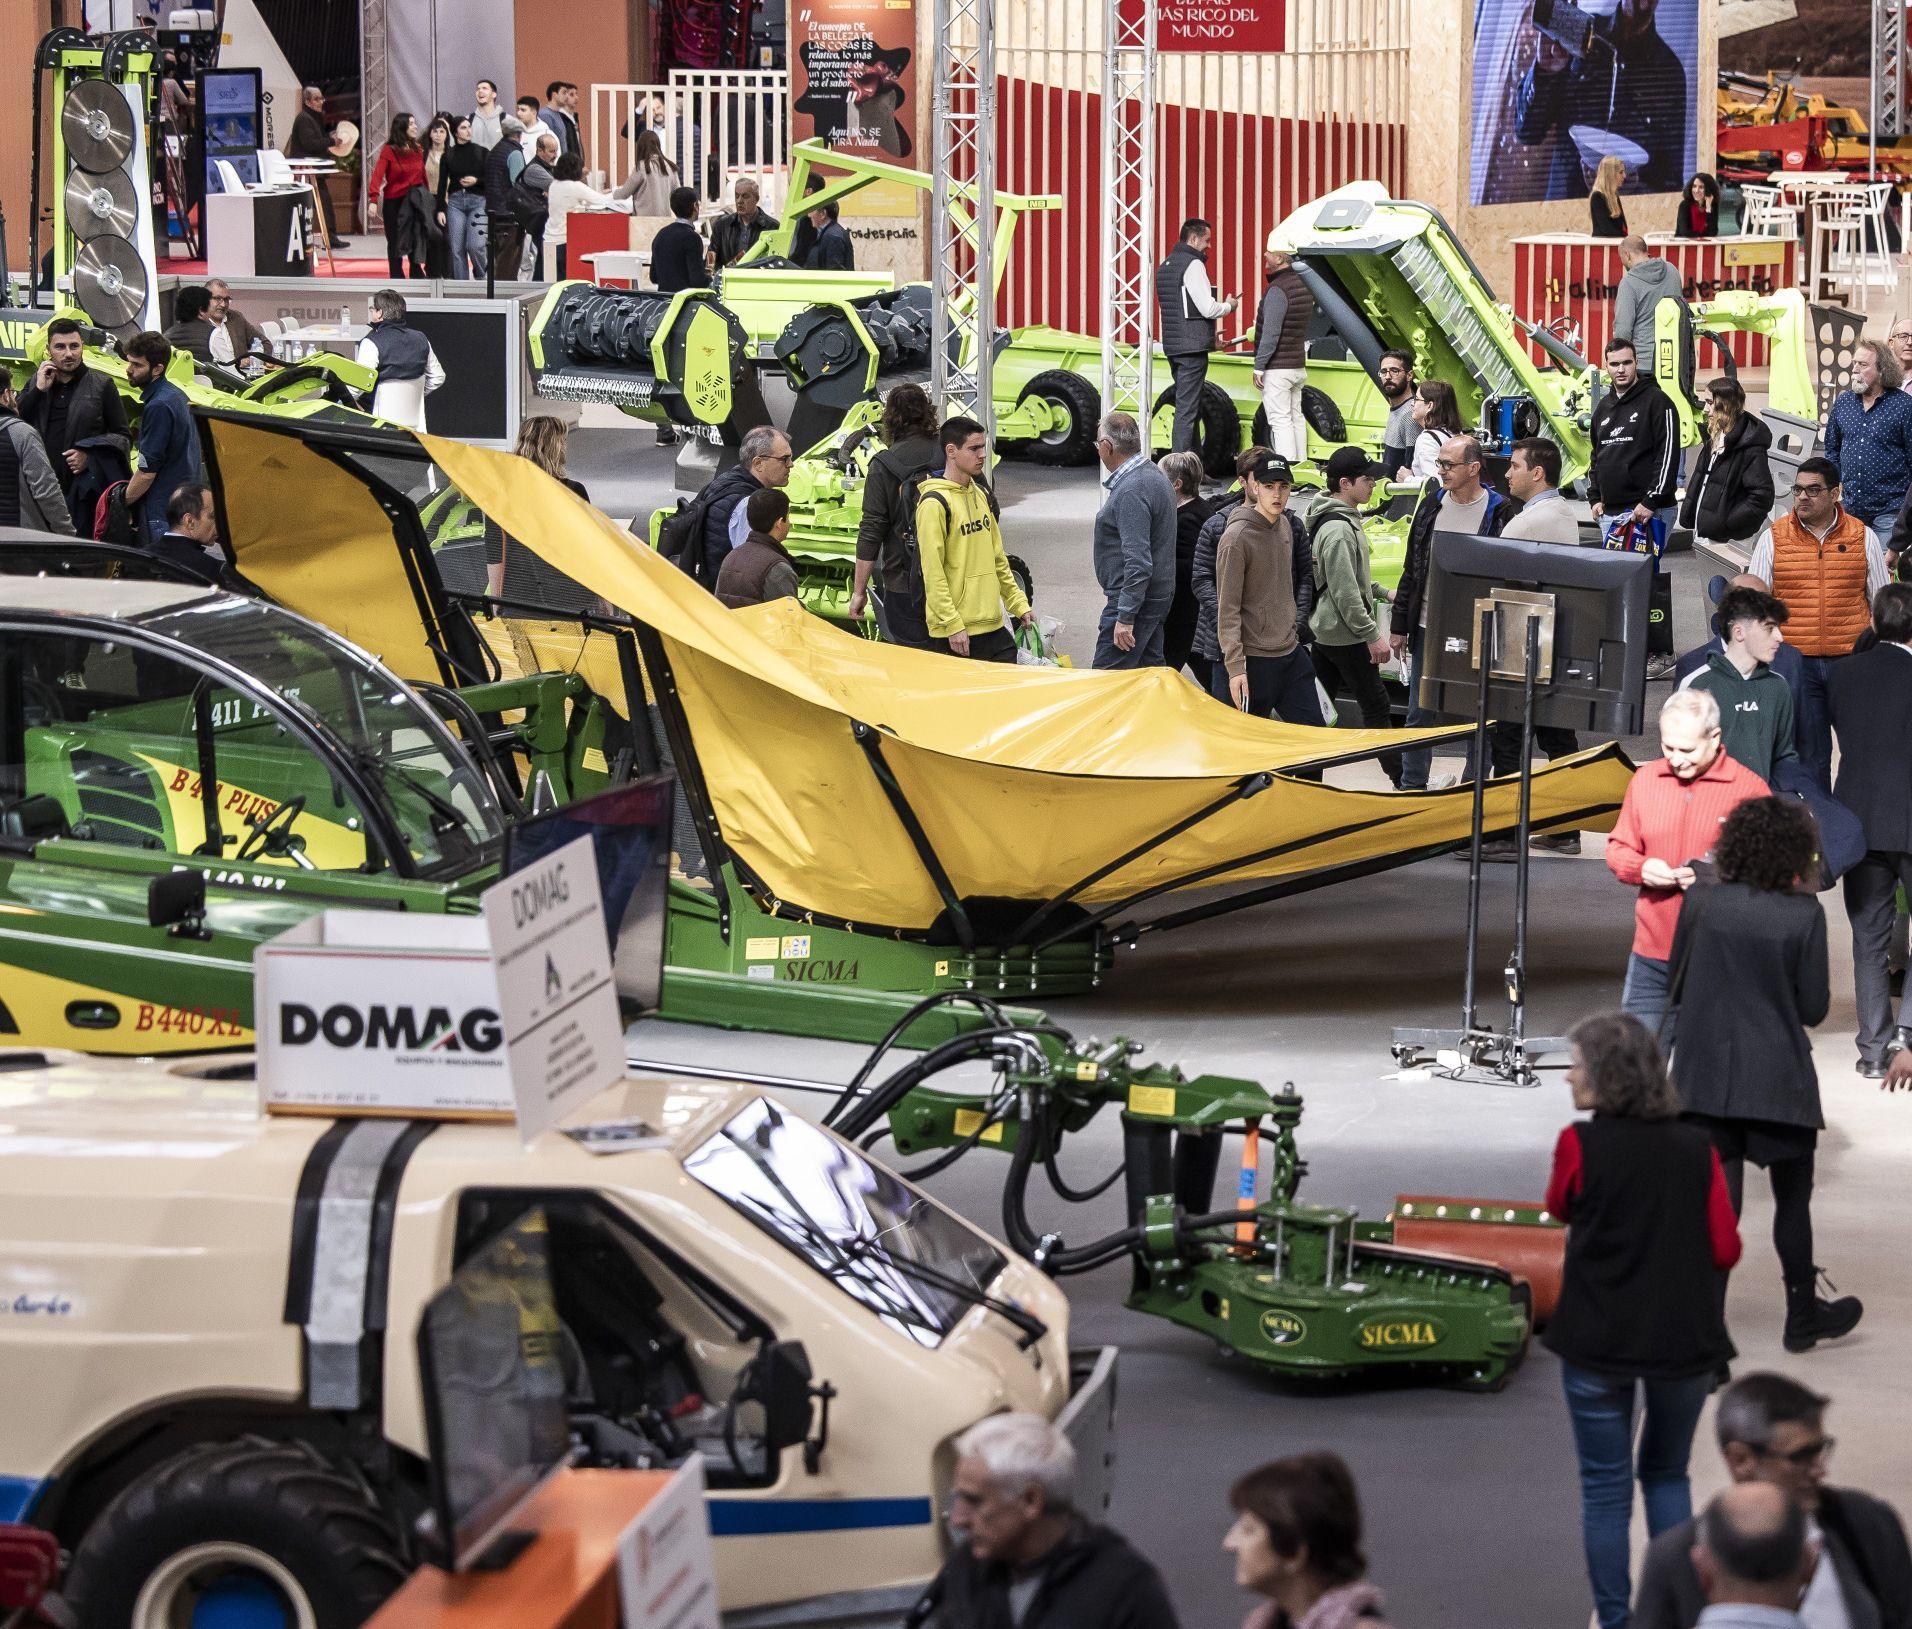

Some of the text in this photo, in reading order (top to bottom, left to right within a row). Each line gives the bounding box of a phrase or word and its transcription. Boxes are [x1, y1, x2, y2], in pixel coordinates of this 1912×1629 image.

[1187, 8, 1227, 21] RICO
[1230, 8, 1259, 21] DEL
[808, 21, 866, 33] El concepto DE
[1172, 25, 1234, 38] MUNDO
[808, 32, 874, 41] LA BELLEZA DE
[808, 41, 874, 50] LAS COSAS ES
[808, 50, 872, 60] relativo, lo más
[808, 60, 865, 71] importante de
[822, 69, 863, 80] producto
[808, 80, 820, 88] es
[821, 79, 829, 88] el
[265, 107, 275, 149] MORES
[849, 127, 867, 137] NO
[869, 127, 881, 137] SE
[832, 138, 880, 147] TIRA Nada
[1661, 342, 1673, 376] NB
[511, 863, 570, 930] DOMAG
[784, 960, 859, 981] SICMA
[281, 1003, 502, 1052] DOMAG
[1361, 1323, 1437, 1345] SICMA
